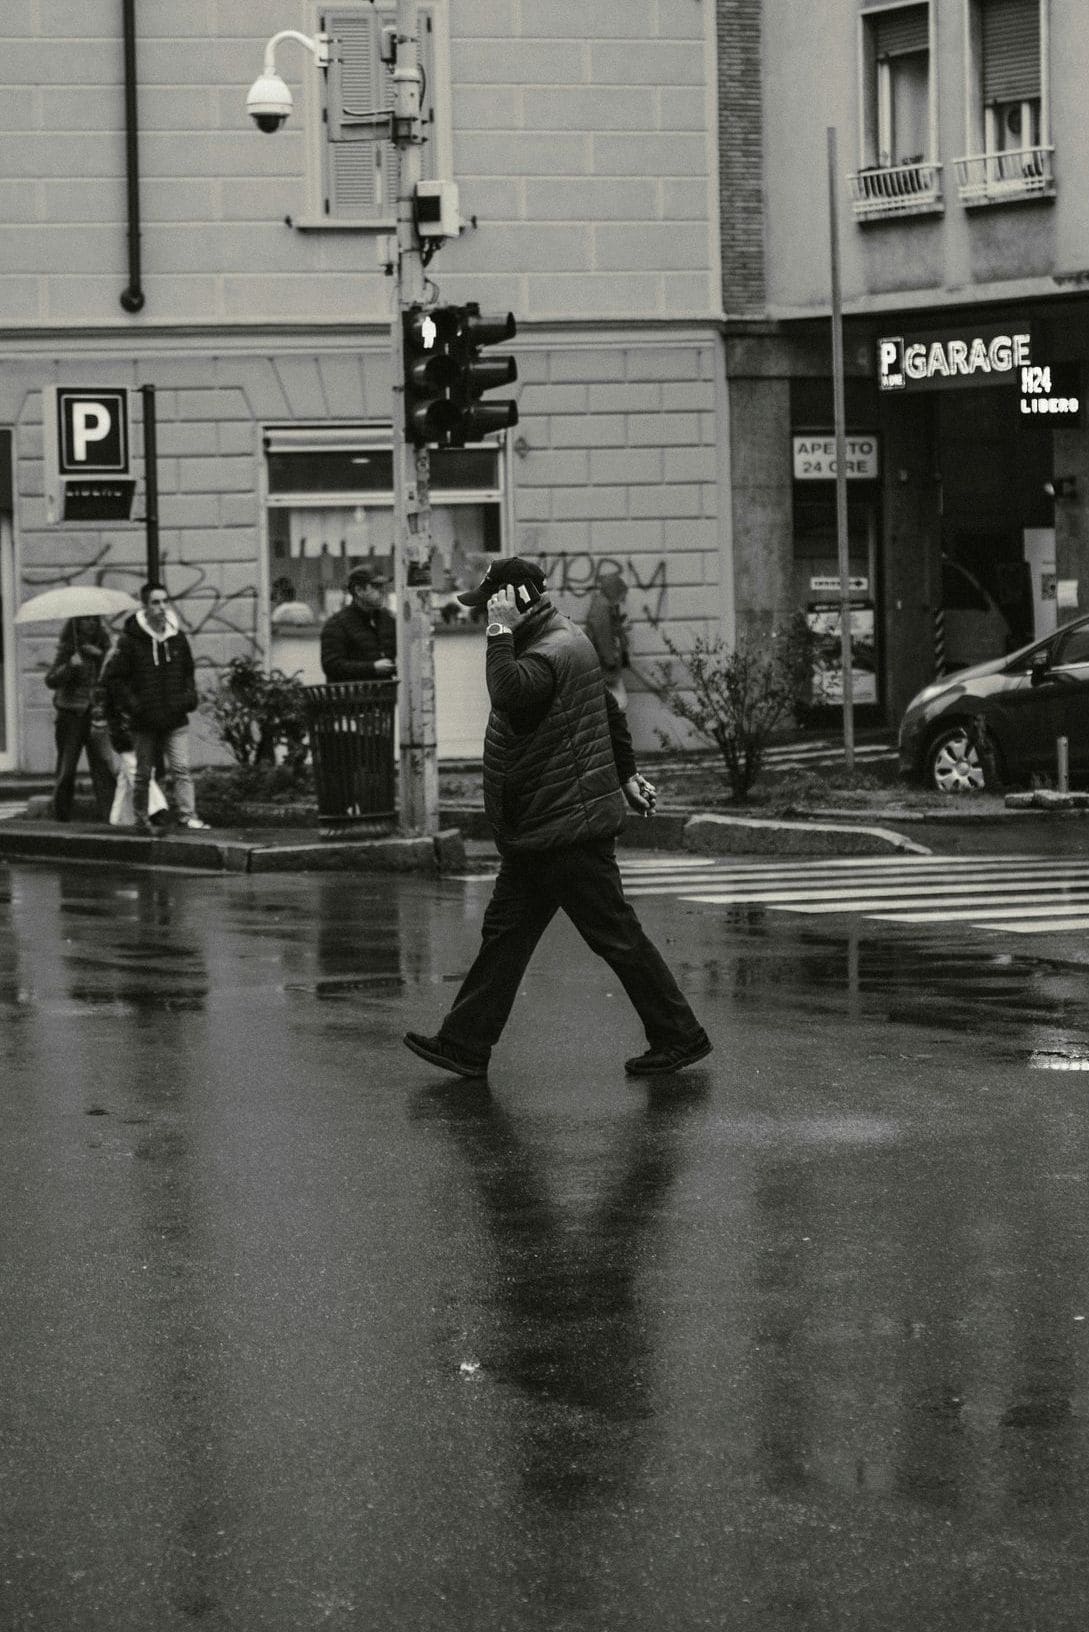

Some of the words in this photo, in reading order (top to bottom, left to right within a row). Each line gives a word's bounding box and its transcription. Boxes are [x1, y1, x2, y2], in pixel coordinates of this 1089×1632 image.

[880, 342, 897, 375] P
[905, 334, 1031, 379] GARAGE
[1021, 366, 1052, 394] H24
[1020, 398, 1079, 414] LIBERO
[72, 402, 111, 461] P
[798, 442, 874, 456] APETO
[802, 461, 822, 474] 24
